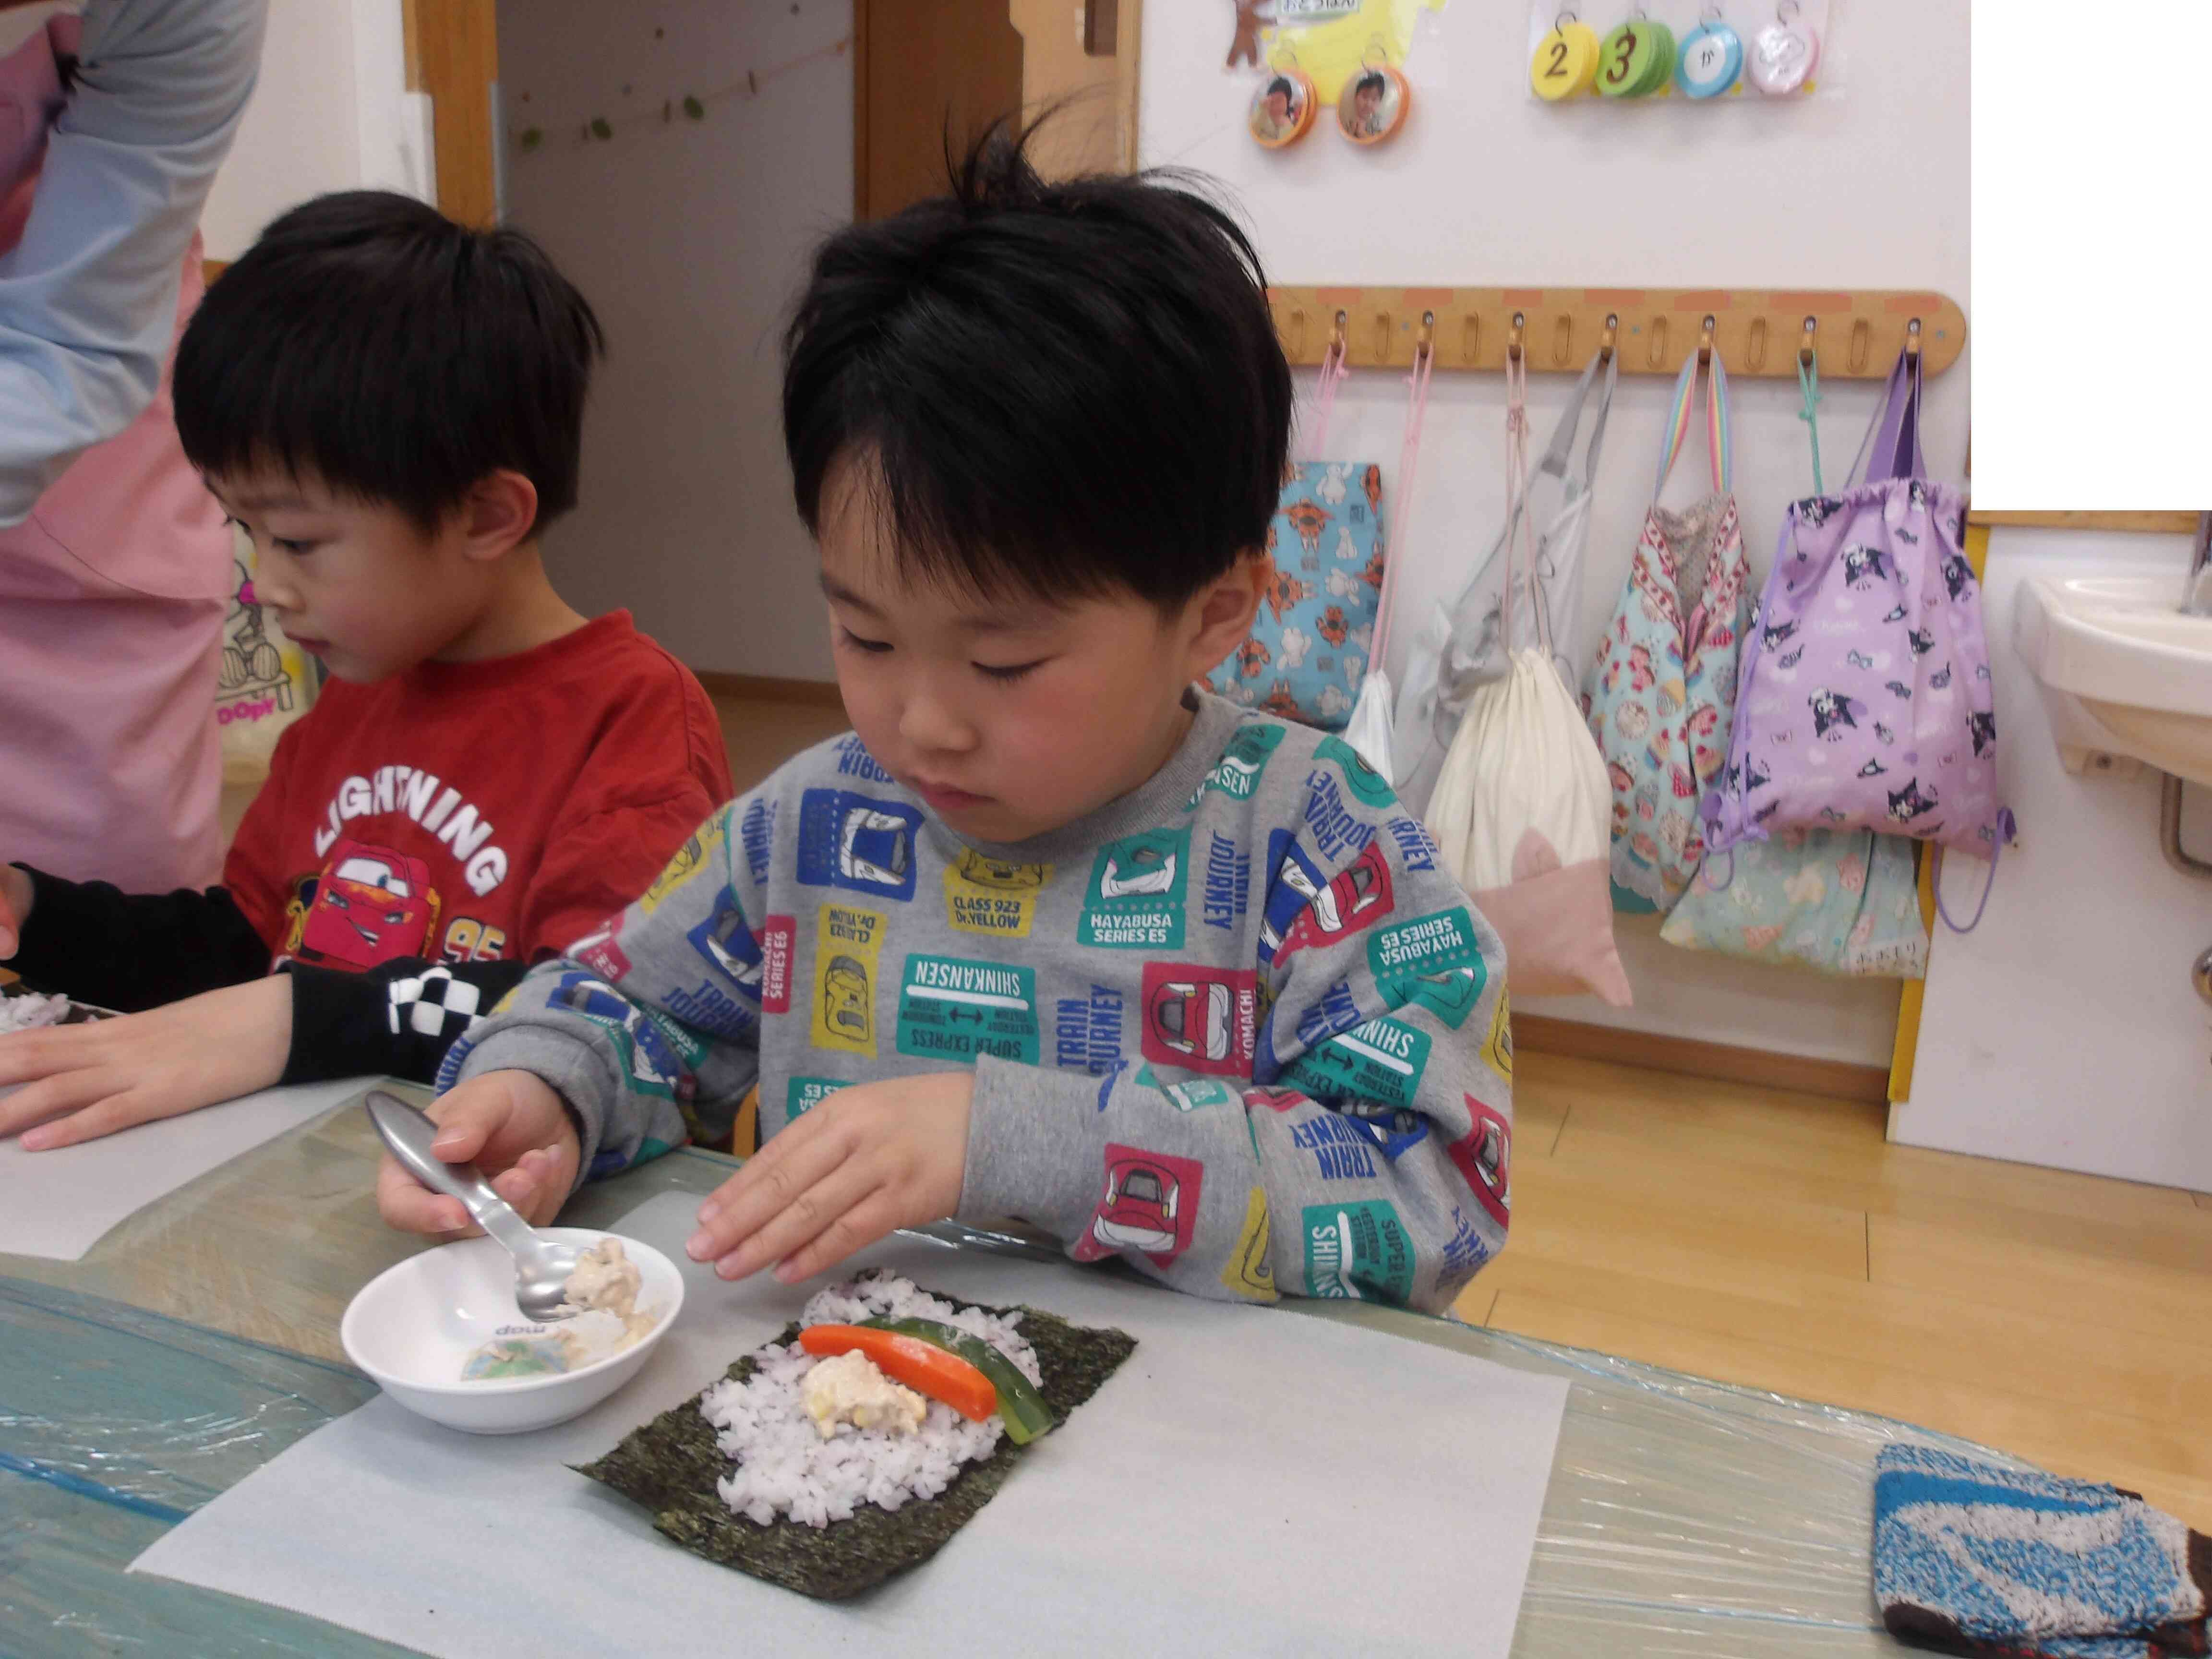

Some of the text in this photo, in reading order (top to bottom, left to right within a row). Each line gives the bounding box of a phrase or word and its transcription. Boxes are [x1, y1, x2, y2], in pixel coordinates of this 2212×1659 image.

[1544, 42, 1568, 78] 2
[1606, 33, 1637, 84] 3
[1203, 830, 1235, 930] JOURNEY
[954, 896, 1022, 914] CLASS 923
[1091, 914, 1172, 929] HAYABUSA
[442, 916, 506, 962] 95
[1094, 928, 1166, 944] SERIES E5
[1380, 930, 1463, 966] HAYABUSA
[1381, 915, 1455, 949] SERIES E5
[770, 930, 788, 999] SERIES E6
[915, 961, 1020, 997] SHINKANSEN
[912, 1029, 970, 1053] EXPRESS
[1056, 999, 1088, 1067] TRAIN
[1314, 1145, 1377, 1180] TRAIN
